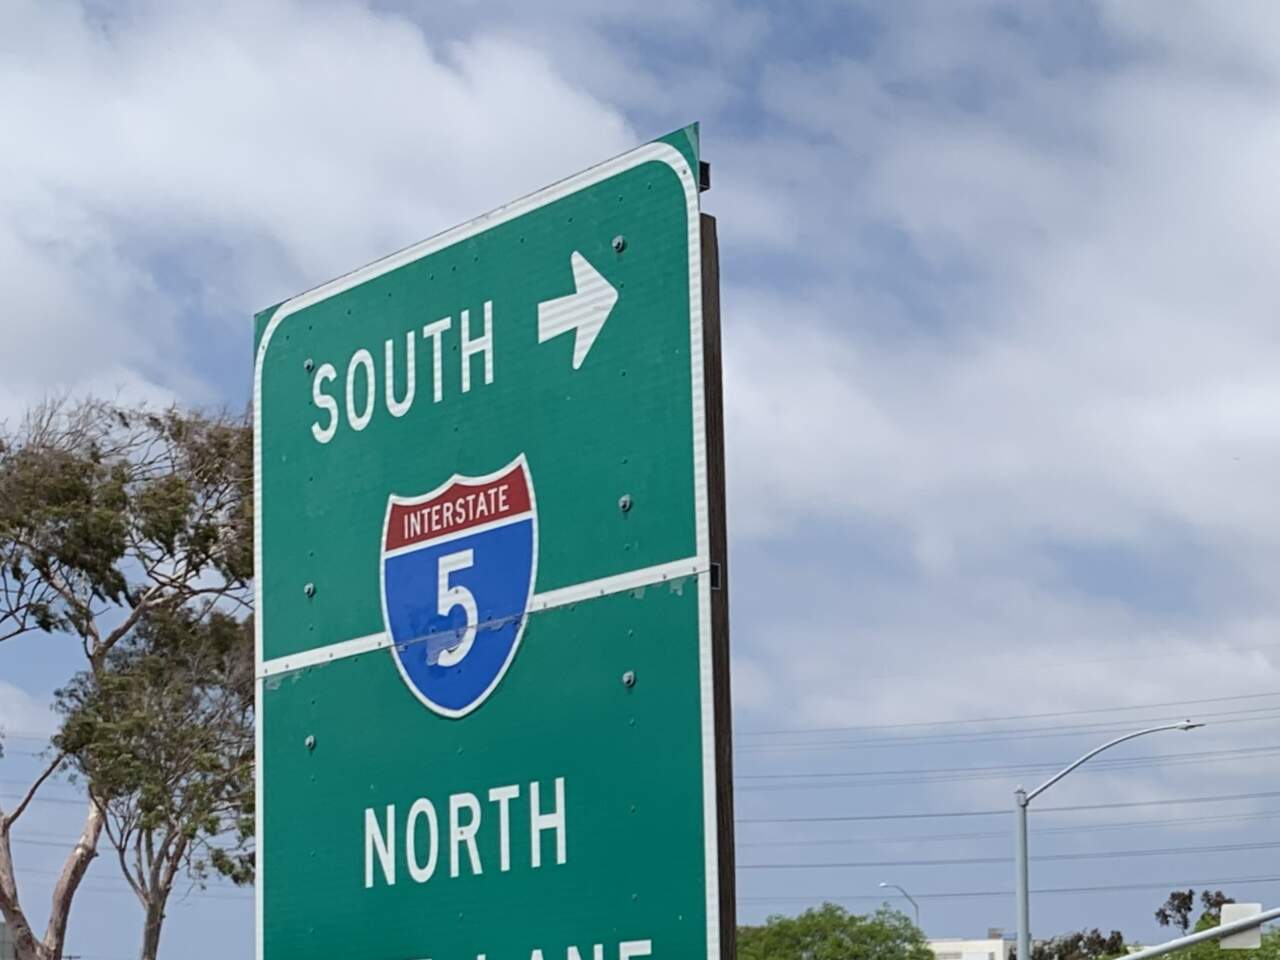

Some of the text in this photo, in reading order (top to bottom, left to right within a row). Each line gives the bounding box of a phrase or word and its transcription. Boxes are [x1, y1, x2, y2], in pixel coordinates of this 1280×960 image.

[311, 300, 495, 444] SOUTH
[404, 484, 510, 540] INTERSTATE
[436, 548, 479, 668] 5
[364, 776, 567, 889] NORTH
